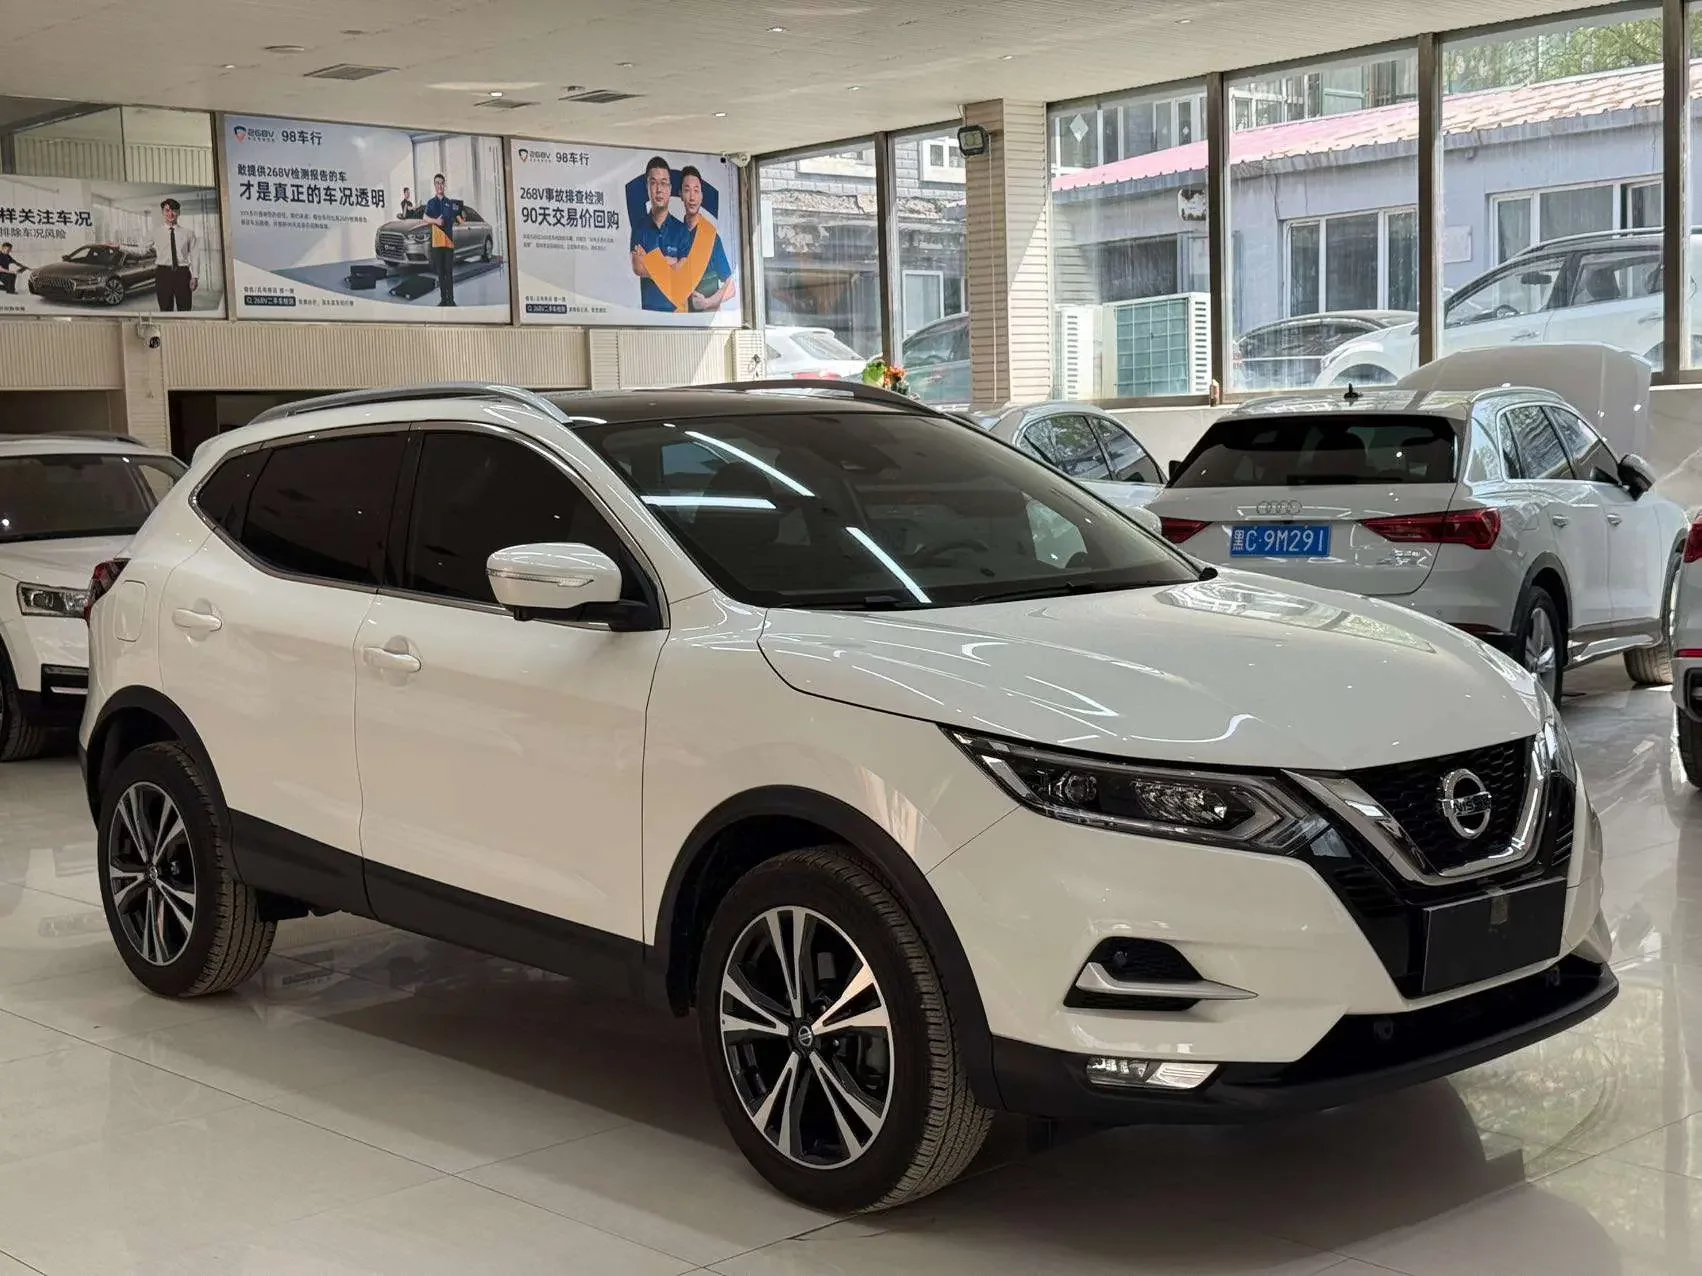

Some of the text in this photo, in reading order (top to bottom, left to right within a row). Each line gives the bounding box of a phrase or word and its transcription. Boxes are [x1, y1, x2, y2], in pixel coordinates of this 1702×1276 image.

[281, 130, 323, 146] 98车行
[556, 151, 589, 166] 98车行
[237, 163, 347, 182] 敢提供268V检测报告的车
[239, 179, 385, 208] 才是真正的车况透明
[520, 186, 605, 206] 268V事故排查检测
[0, 207, 92, 227] 样关注车况
[521, 206, 620, 230] 90天交易价回购
